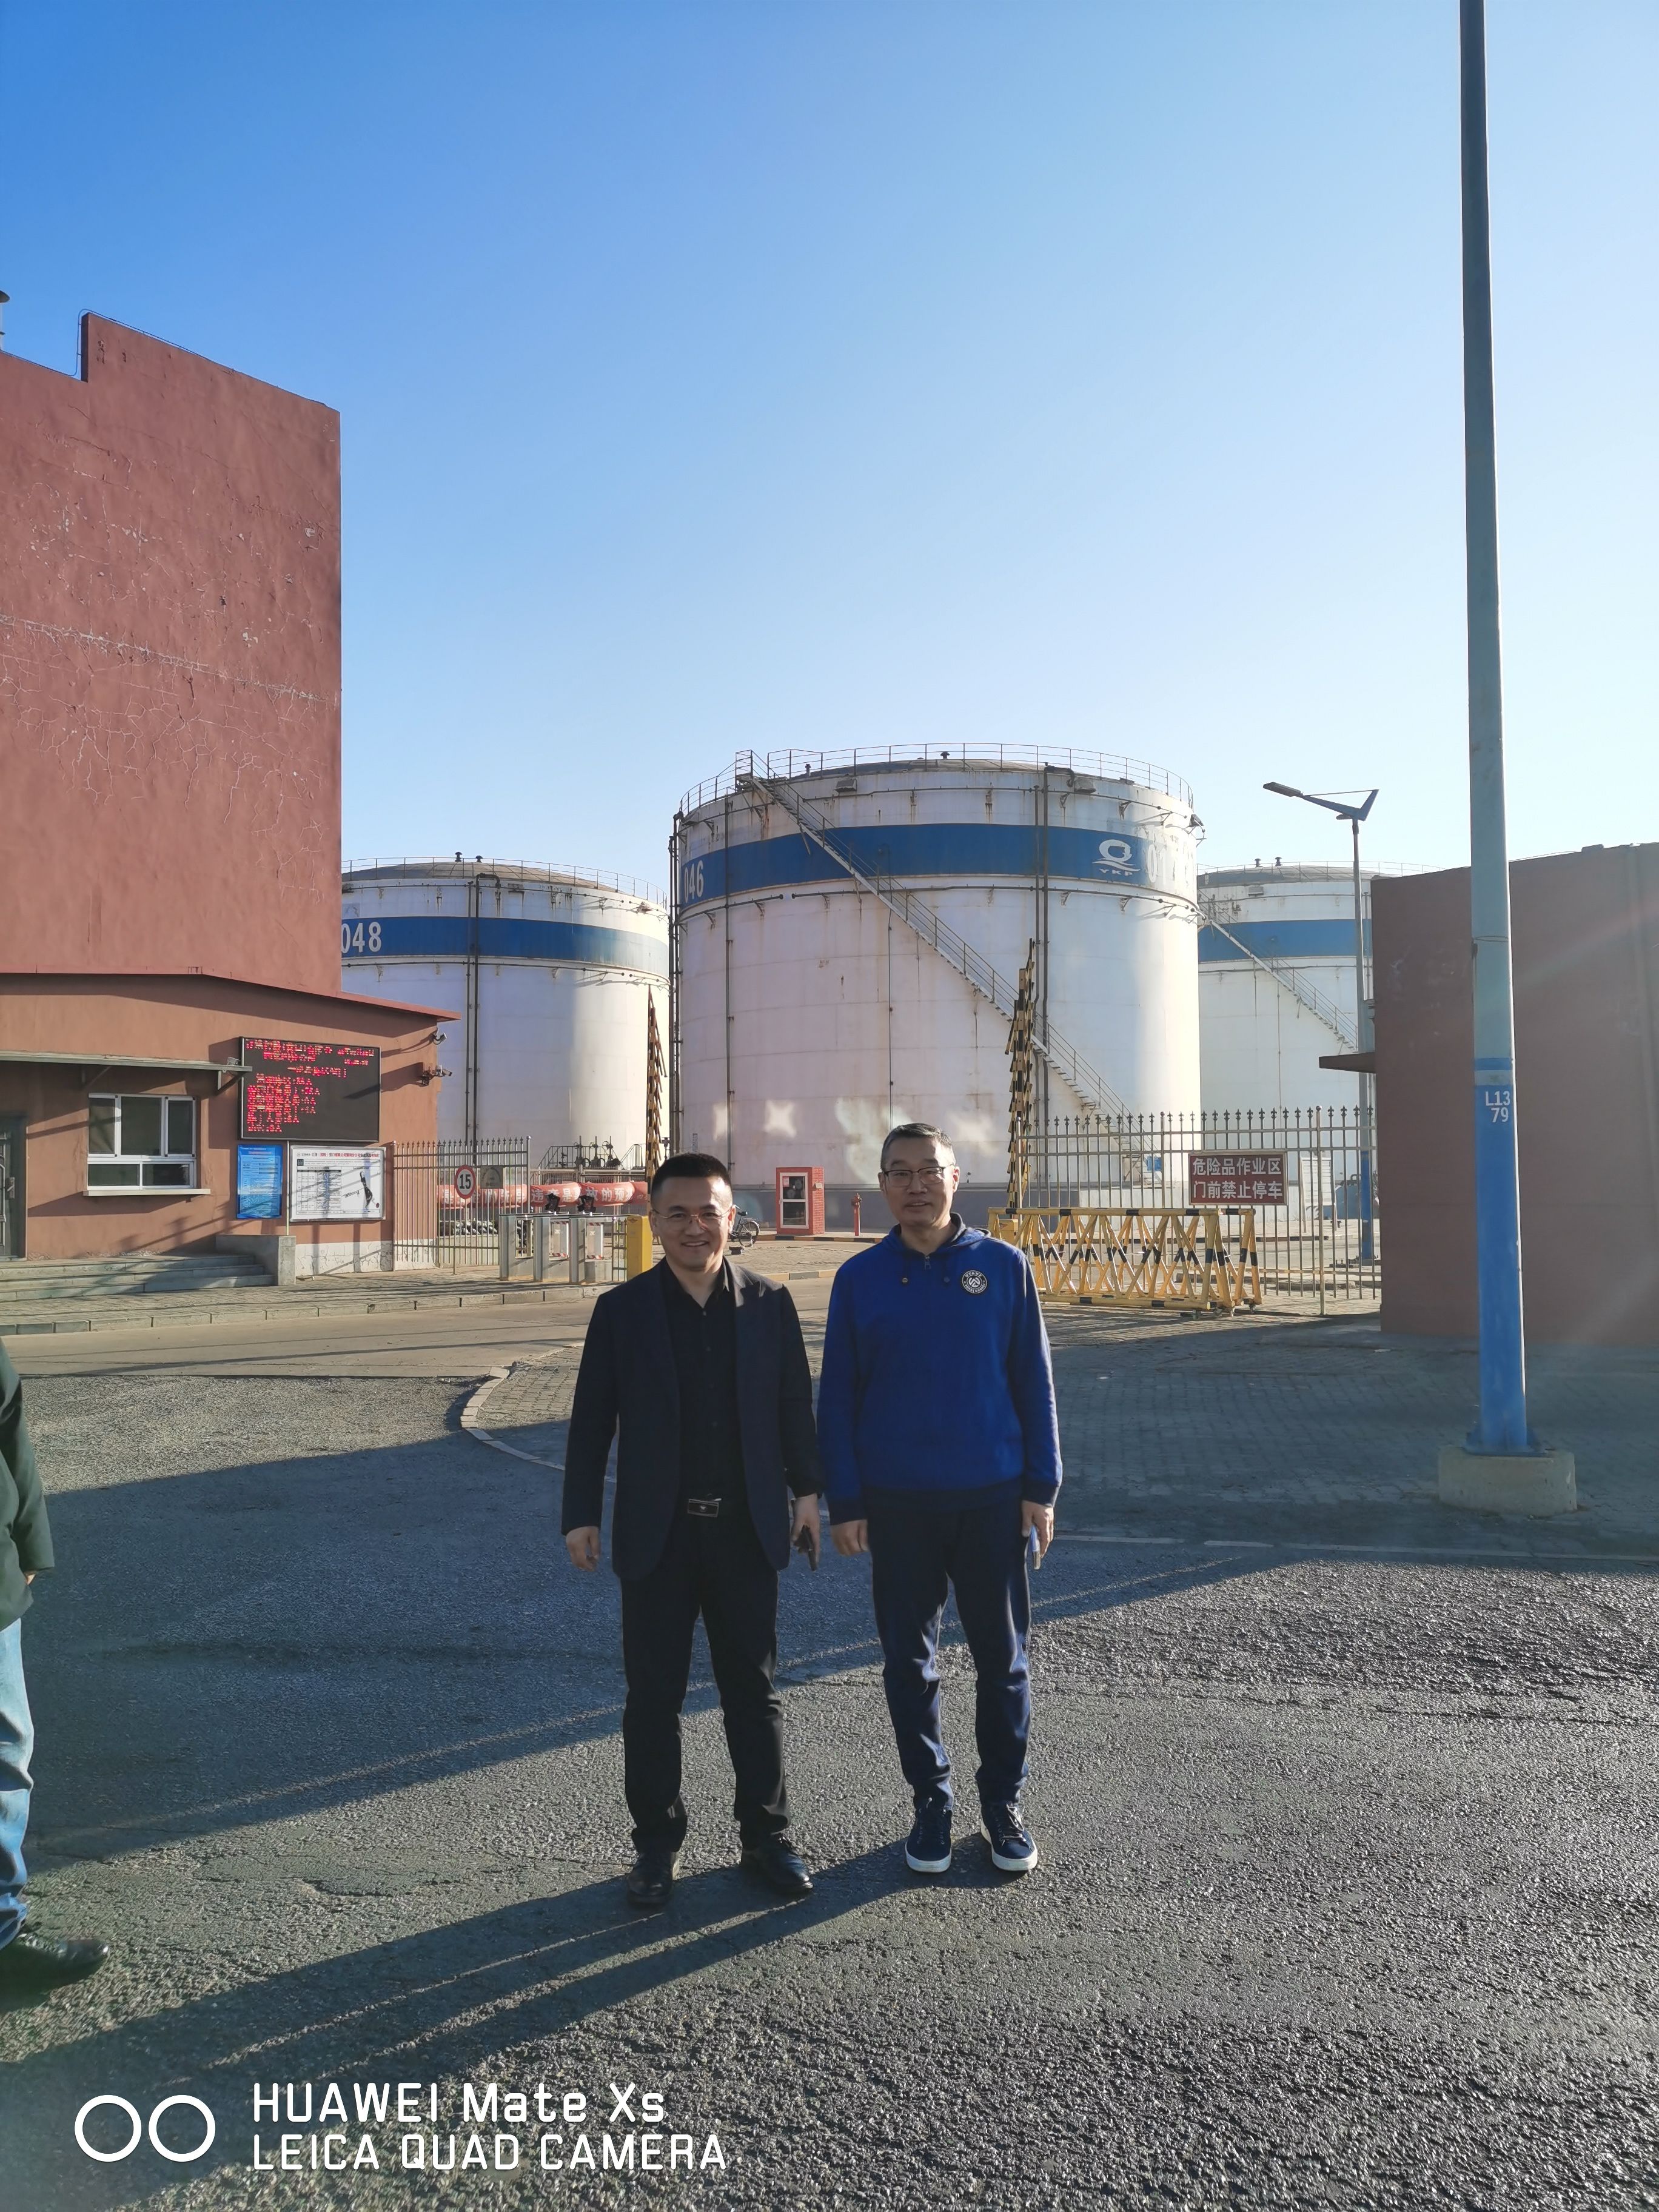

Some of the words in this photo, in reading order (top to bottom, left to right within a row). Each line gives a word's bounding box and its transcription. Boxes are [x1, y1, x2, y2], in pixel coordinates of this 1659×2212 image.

[1098, 868, 1133, 876] YKP
[684, 860, 704, 903] 046
[341, 921, 381, 954] 048
[1485, 1090, 1510, 1107] L13
[1490, 1107, 1509, 1123] 79
[1192, 1157, 1282, 1176] 危险品作业区
[459, 1174, 471, 1190] 15
[1193, 1181, 1283, 1199] 门前禁止停车
